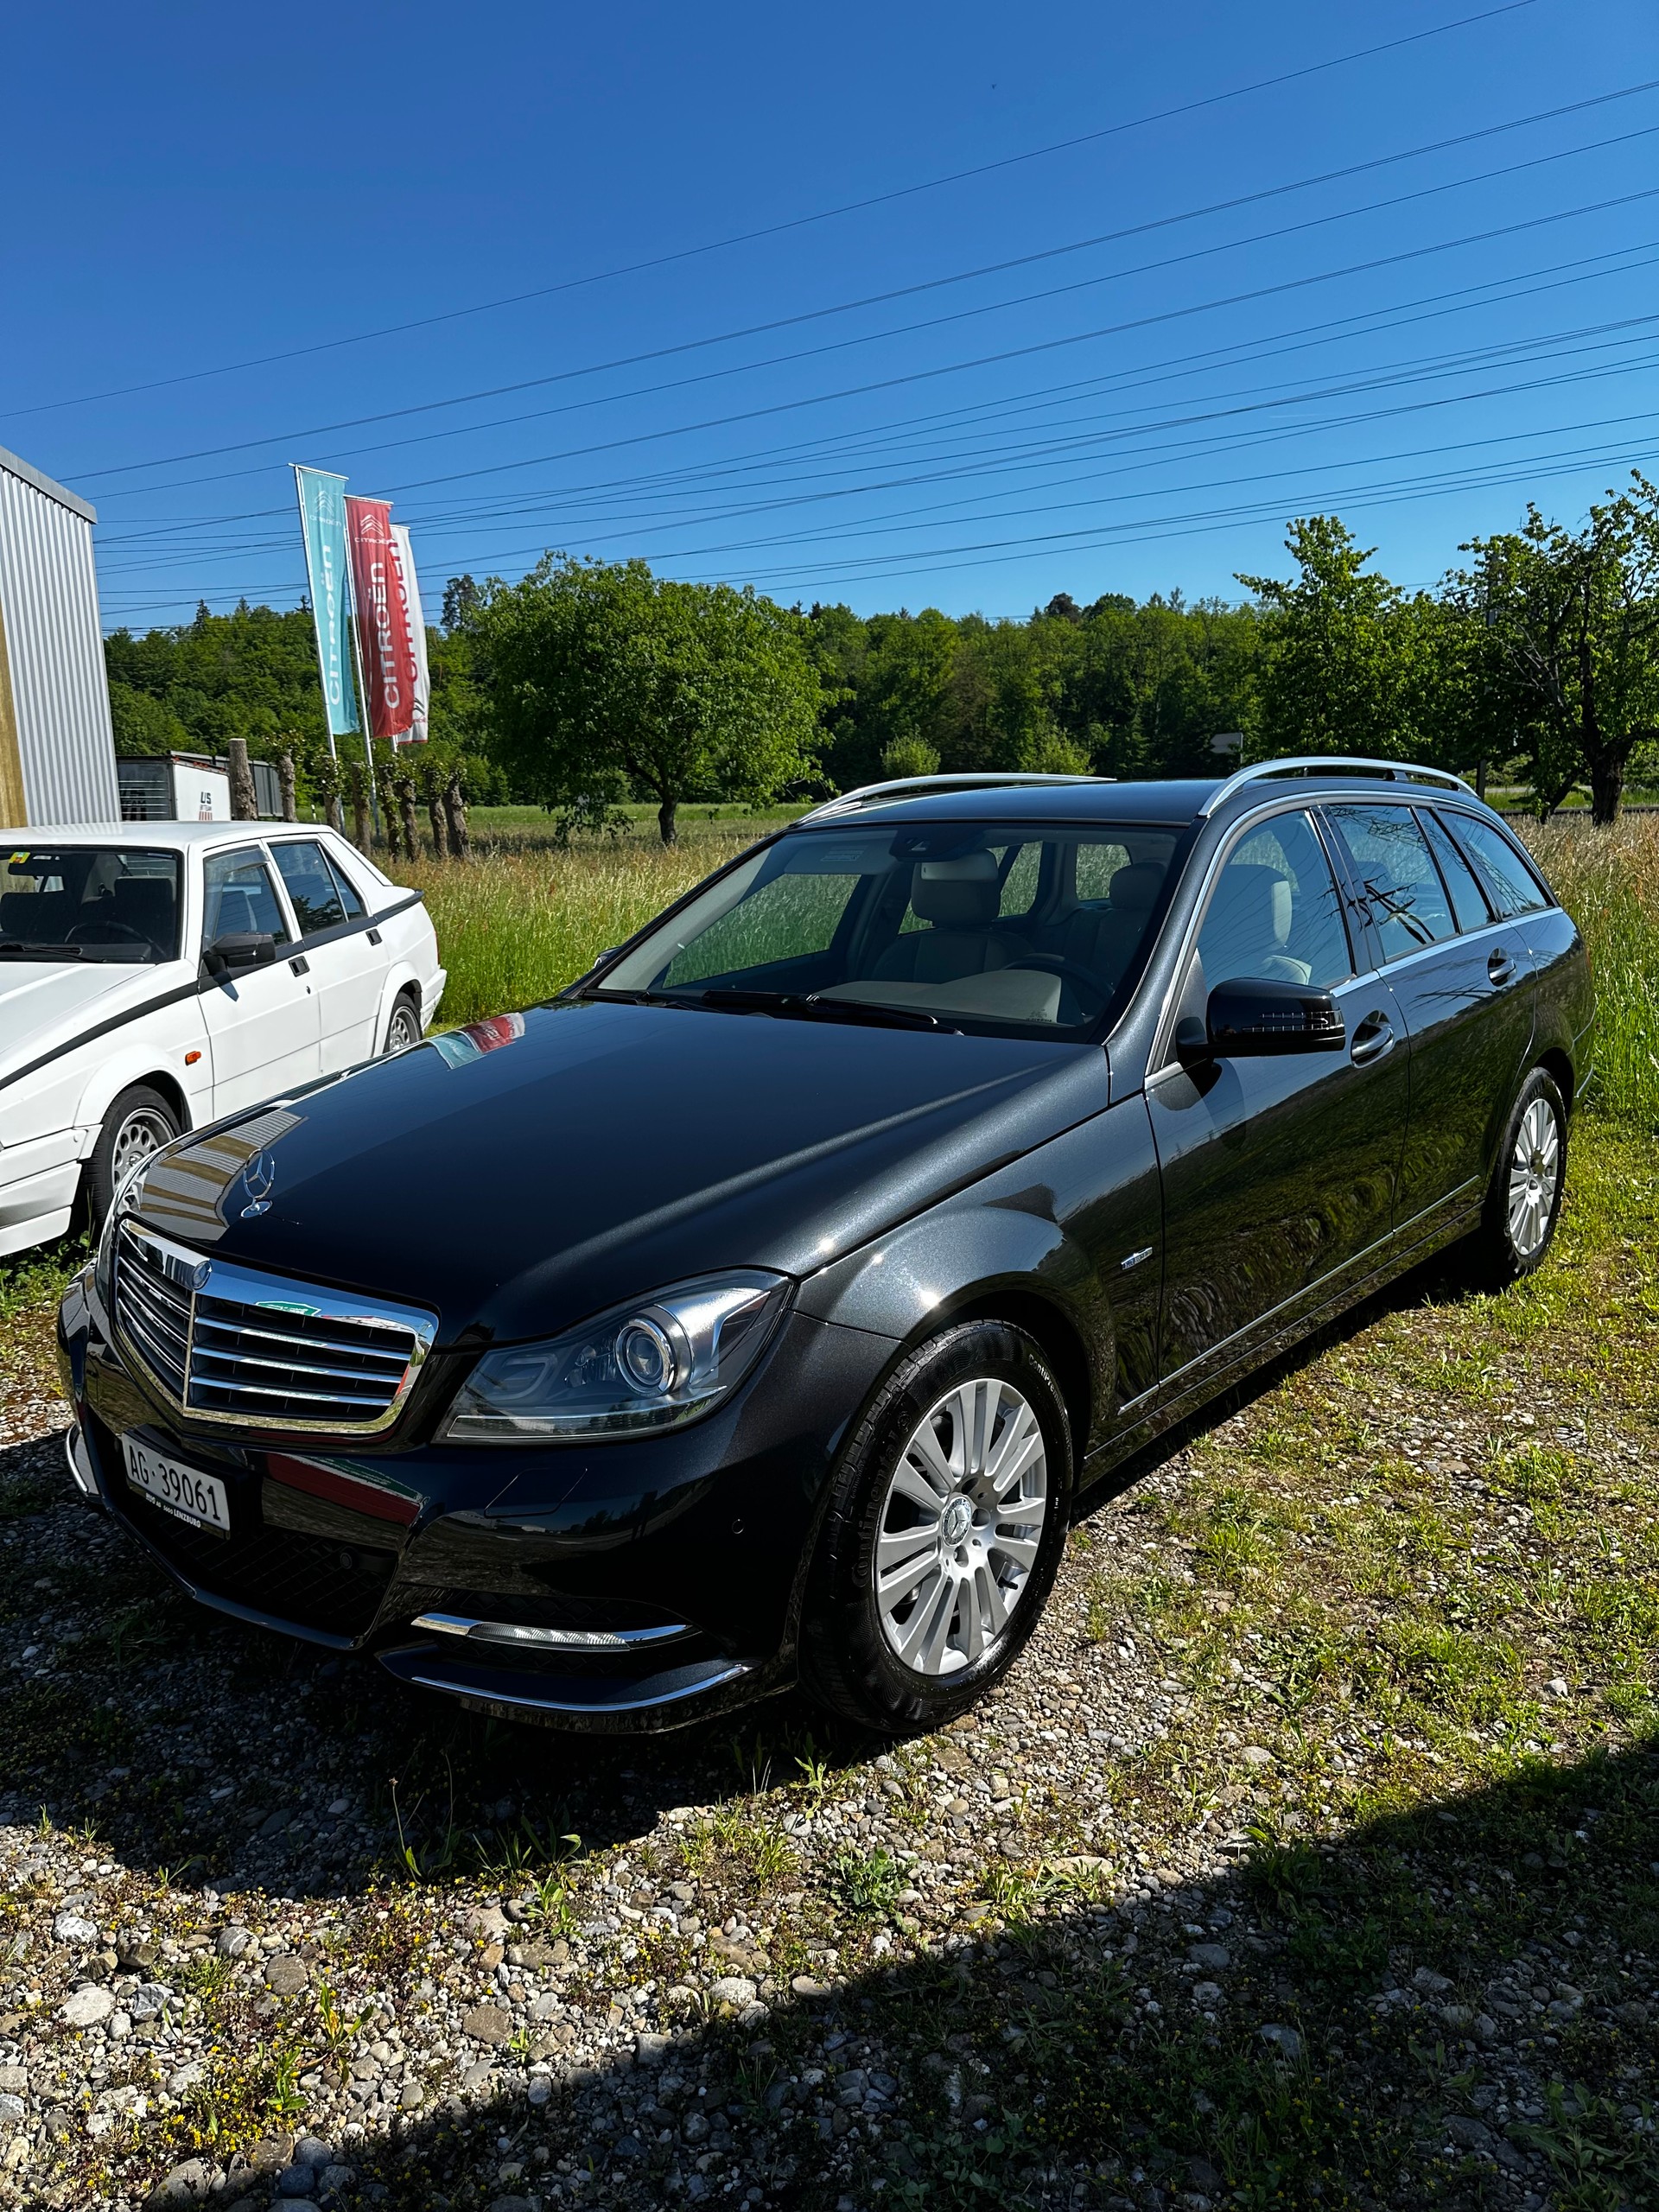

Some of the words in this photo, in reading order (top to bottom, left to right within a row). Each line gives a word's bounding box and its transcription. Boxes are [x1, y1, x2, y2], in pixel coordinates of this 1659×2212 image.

[321, 545, 340, 706] CITROËN
[368, 562, 400, 709] CITROËN
[173, 1509, 201, 1529] LENZBURG
[851, 1429, 901, 1588] Continental
